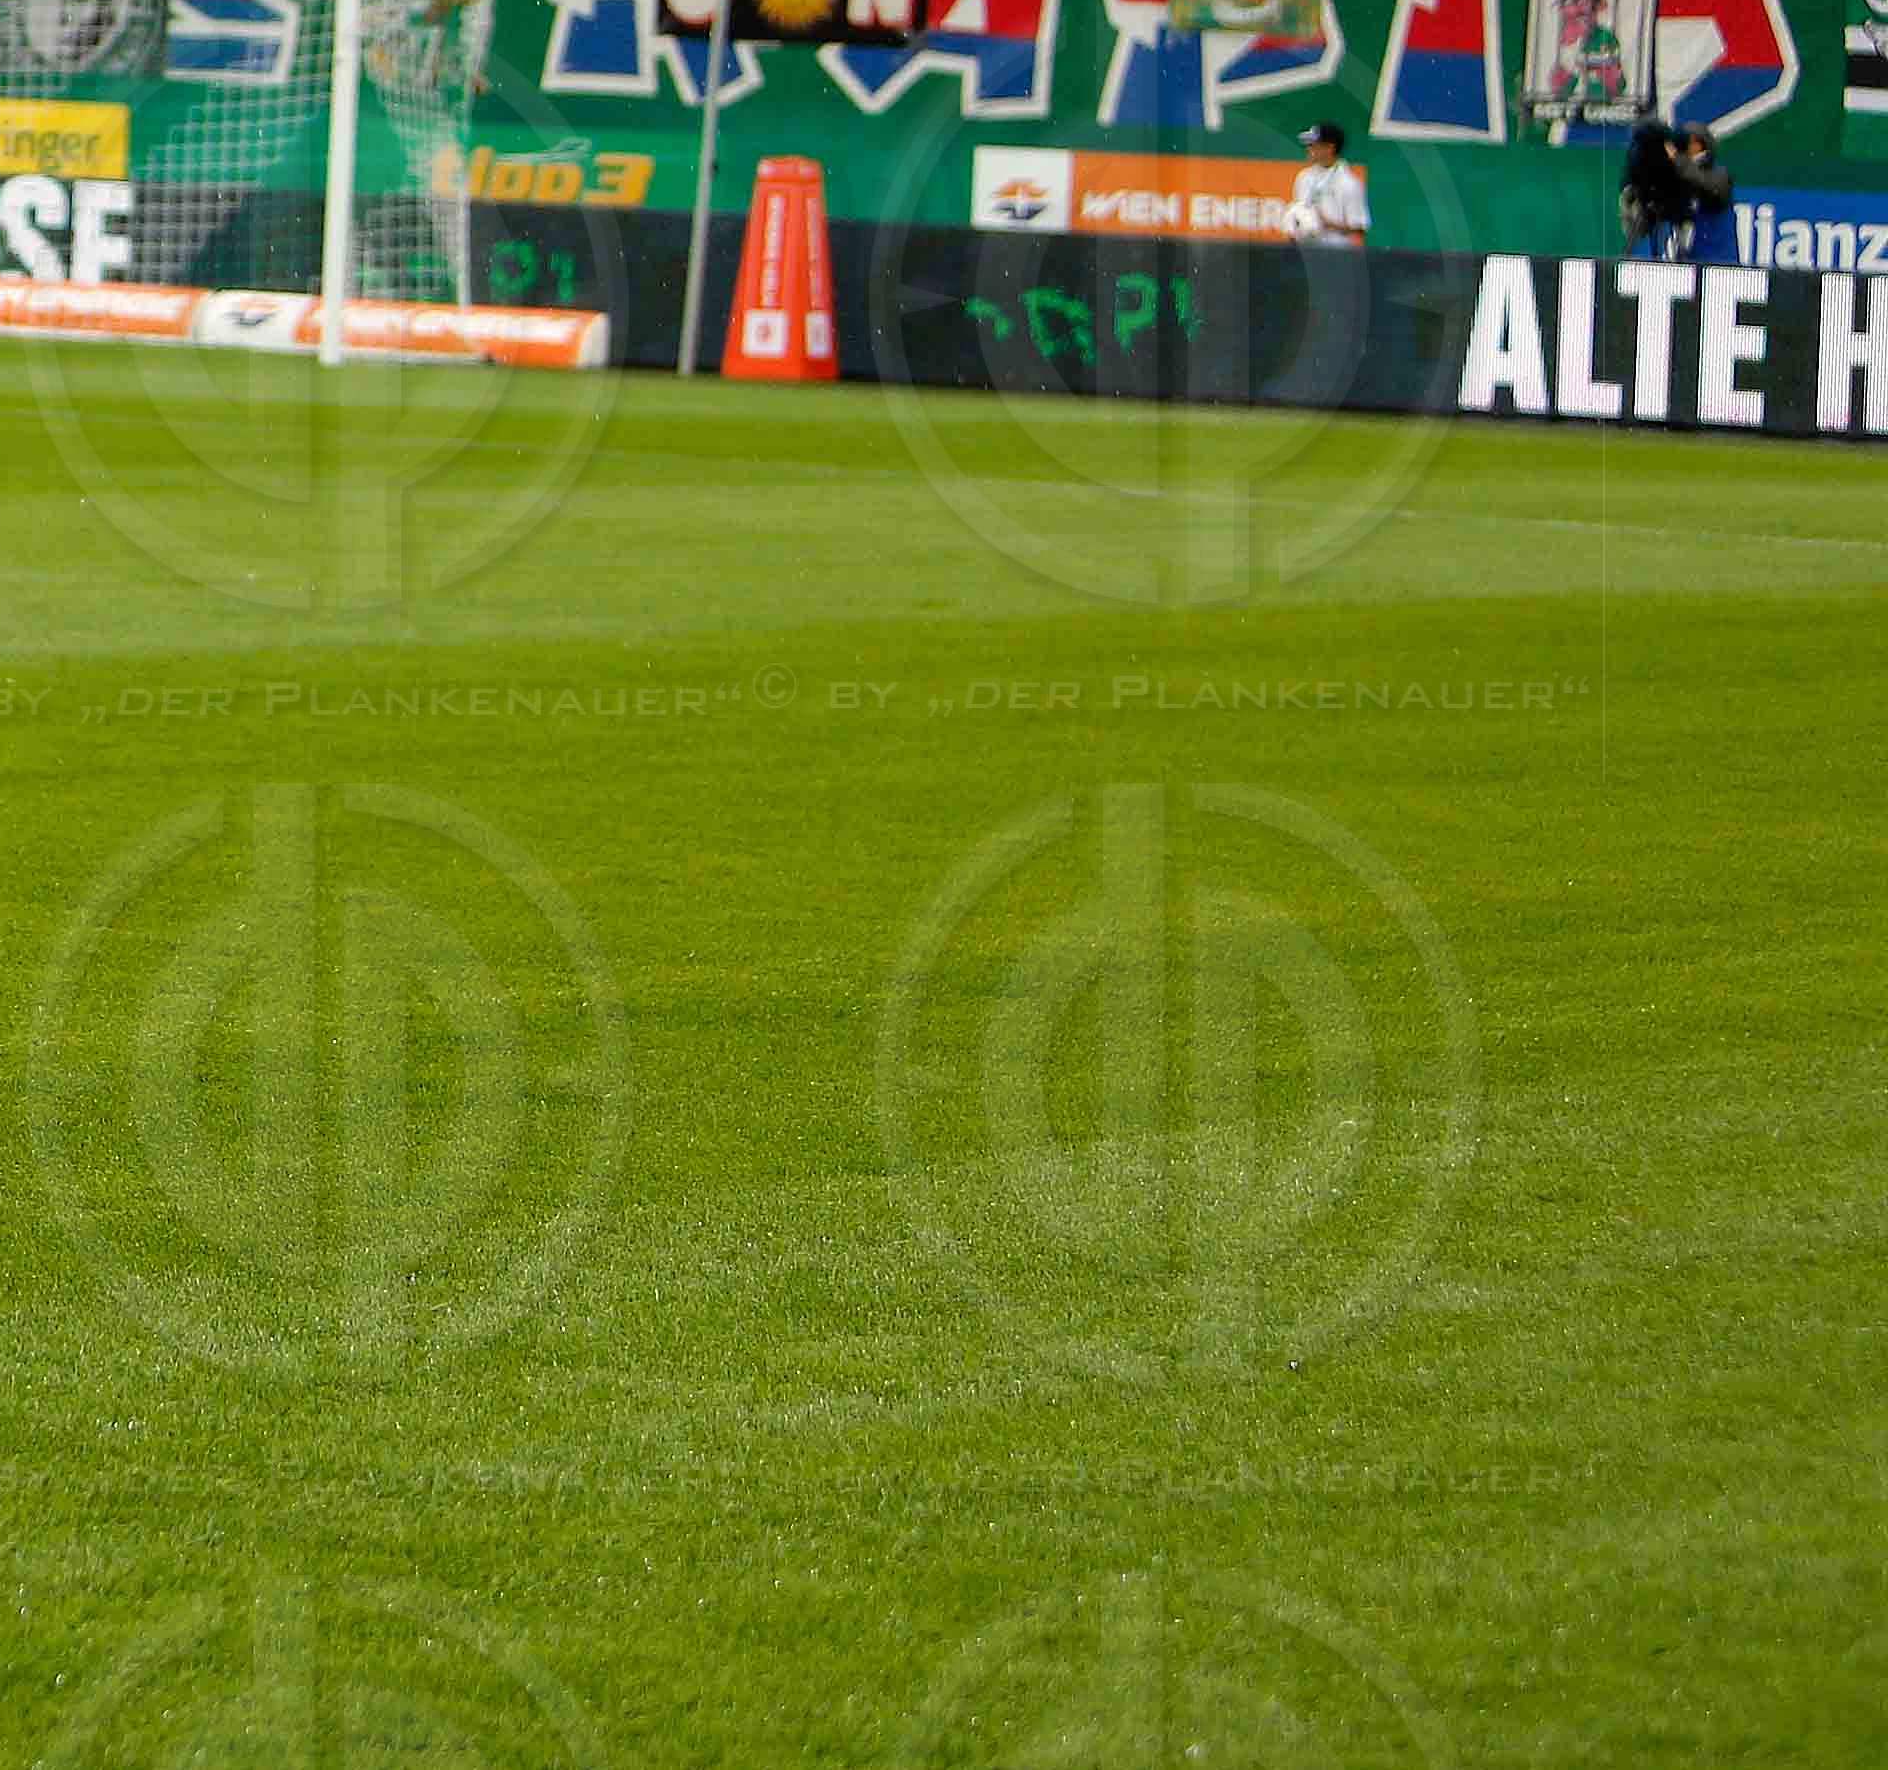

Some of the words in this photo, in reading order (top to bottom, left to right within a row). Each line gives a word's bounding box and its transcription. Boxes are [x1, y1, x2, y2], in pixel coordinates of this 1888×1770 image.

[1081, 189, 1182, 225] WIEN
[1190, 195, 1286, 233] ENER
[1733, 202, 1888, 273] lianz
[1457, 253, 1770, 430] ALTE
